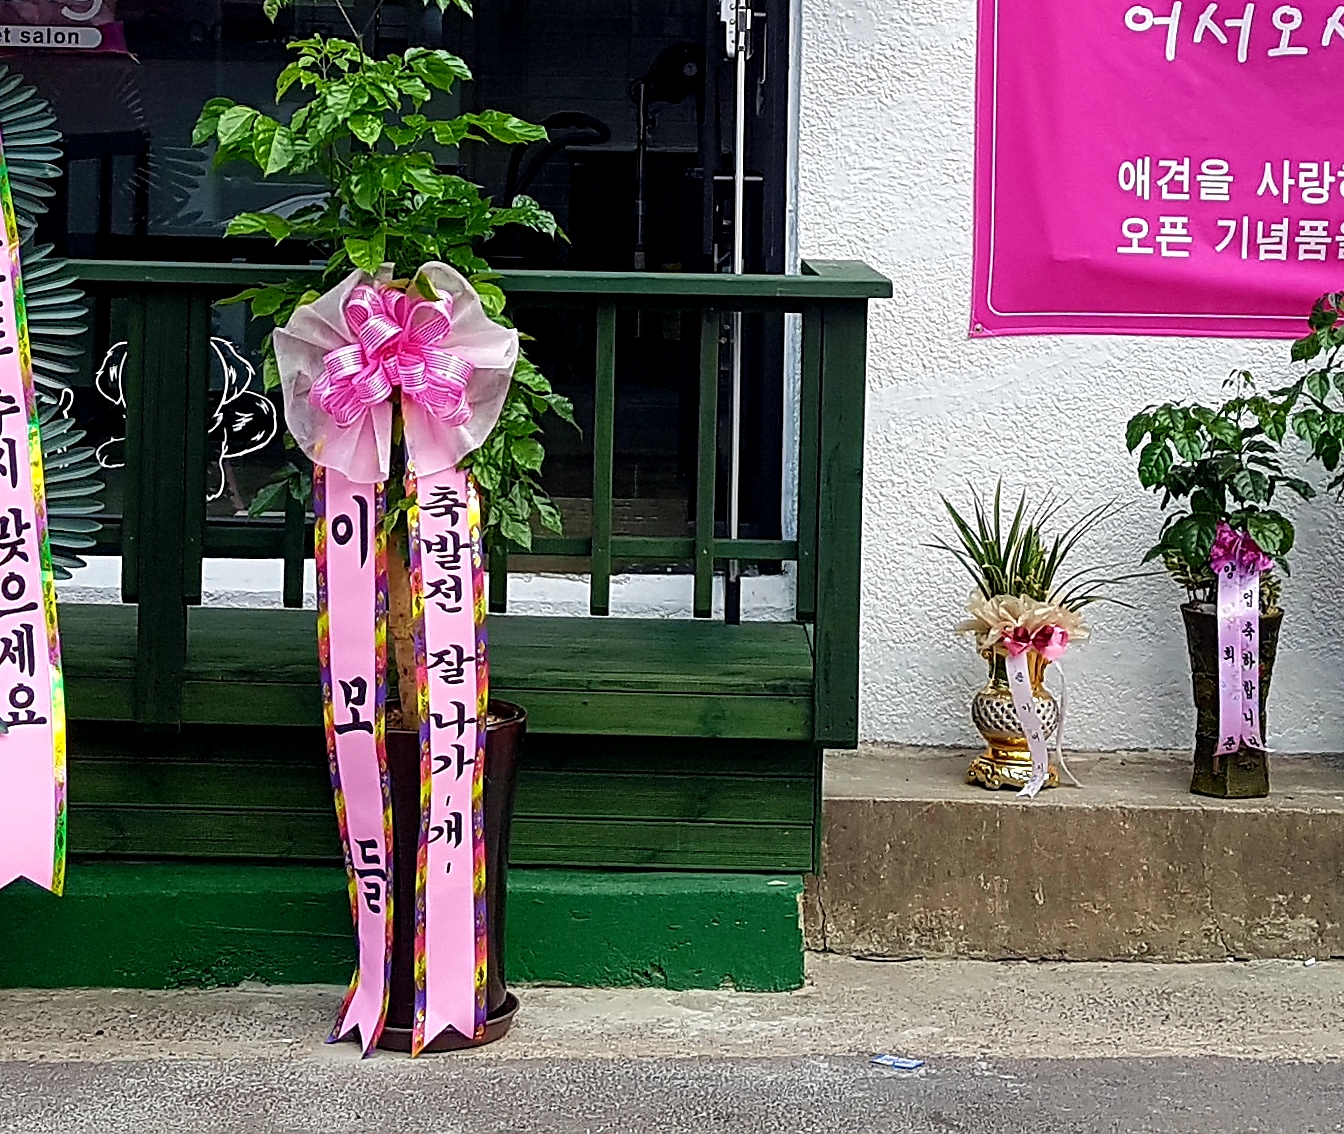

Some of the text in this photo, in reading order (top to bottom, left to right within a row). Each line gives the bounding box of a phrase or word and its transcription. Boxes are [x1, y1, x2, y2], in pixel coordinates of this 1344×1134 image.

[19, 26, 81, 46] salon
[1118, 156, 1234, 202] 애견을
[1116, 216, 1193, 259] 오픈
[419, 484, 471, 614] 축발전
[331, 494, 387, 915] 이모들
